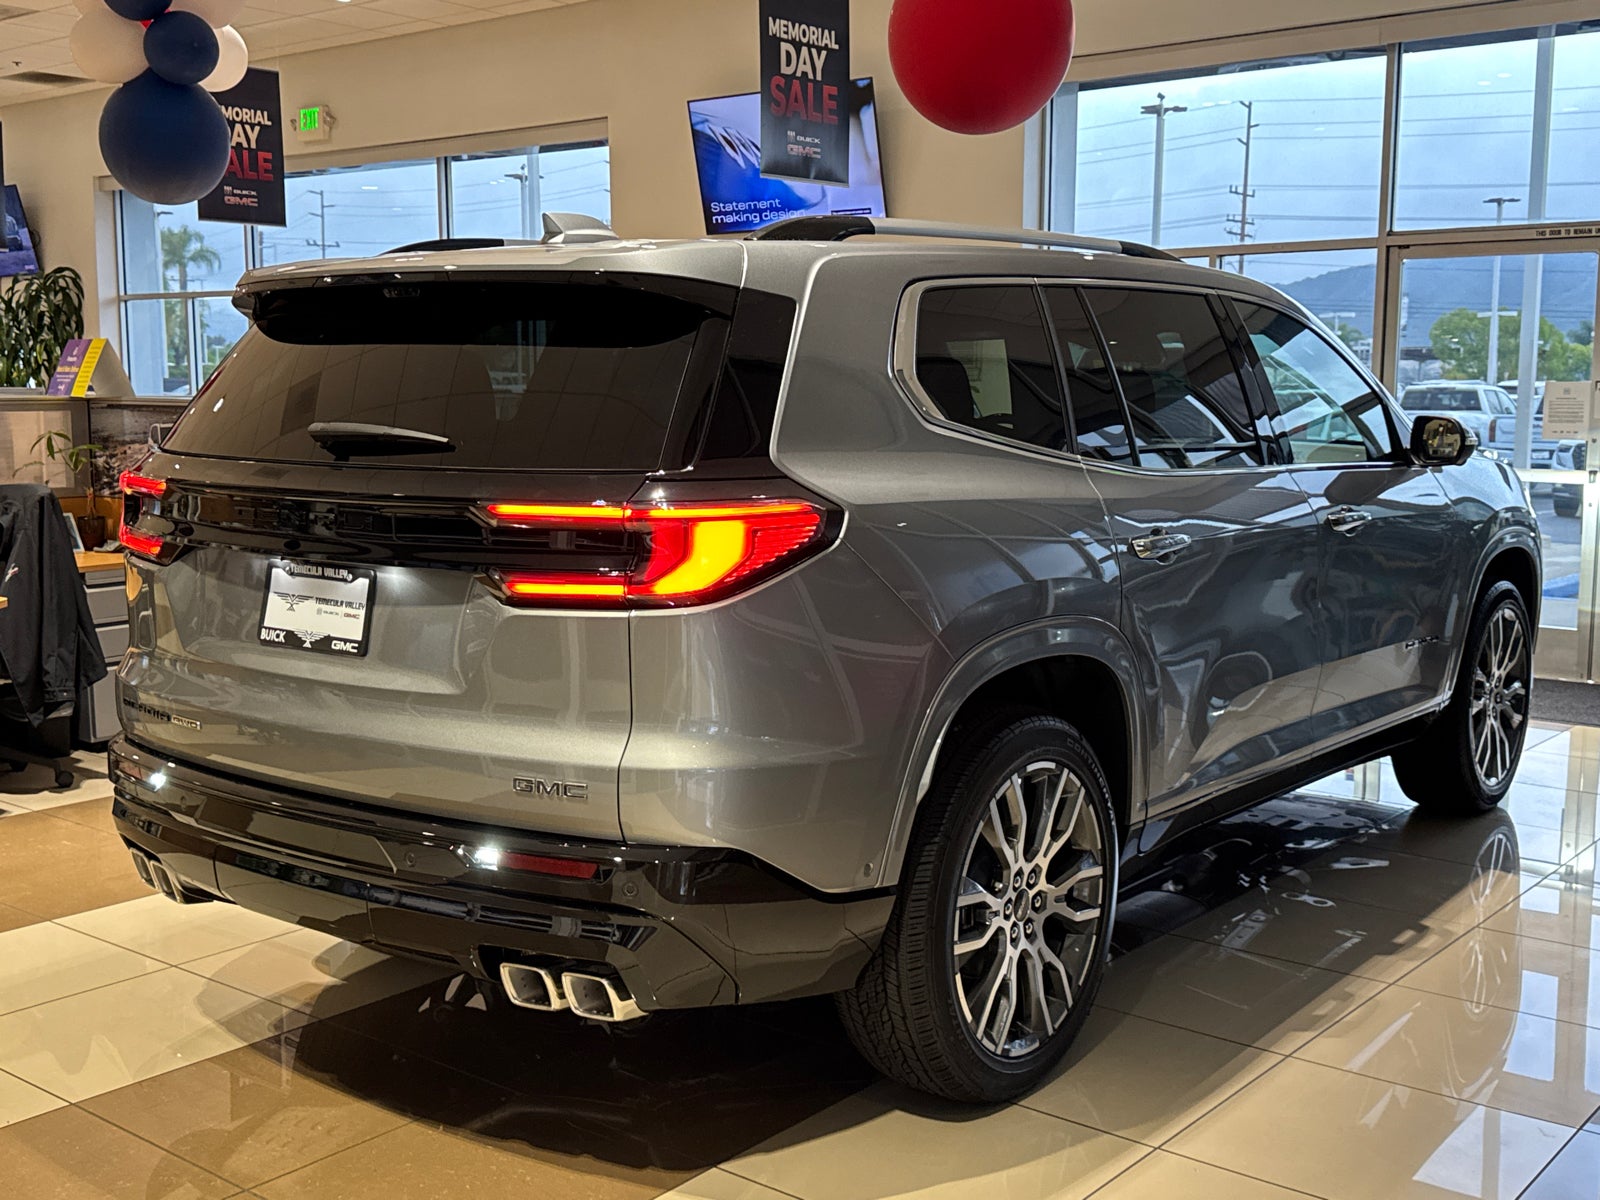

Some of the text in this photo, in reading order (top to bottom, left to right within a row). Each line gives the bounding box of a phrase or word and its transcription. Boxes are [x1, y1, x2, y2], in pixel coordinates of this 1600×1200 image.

[768, 16, 840, 50] MEMORIAL
[780, 41, 827, 81] DAY
[770, 75, 839, 124] SALE
[221, 105, 272, 125] MORIAL
[300, 106, 319, 131] EXIT
[231, 123, 260, 149] AY
[787, 144, 821, 158] GMC
[225, 149, 273, 181] ALE
[224, 196, 258, 206] GMC
[710, 198, 781, 212] Statement
[712, 208, 806, 224] making design
[323, 567, 349, 579] VALLEY
[315, 596, 366, 611] TEMECULA VALLEY
[260, 628, 359, 653] BUICK GMC
[512, 776, 588, 800] GMC
